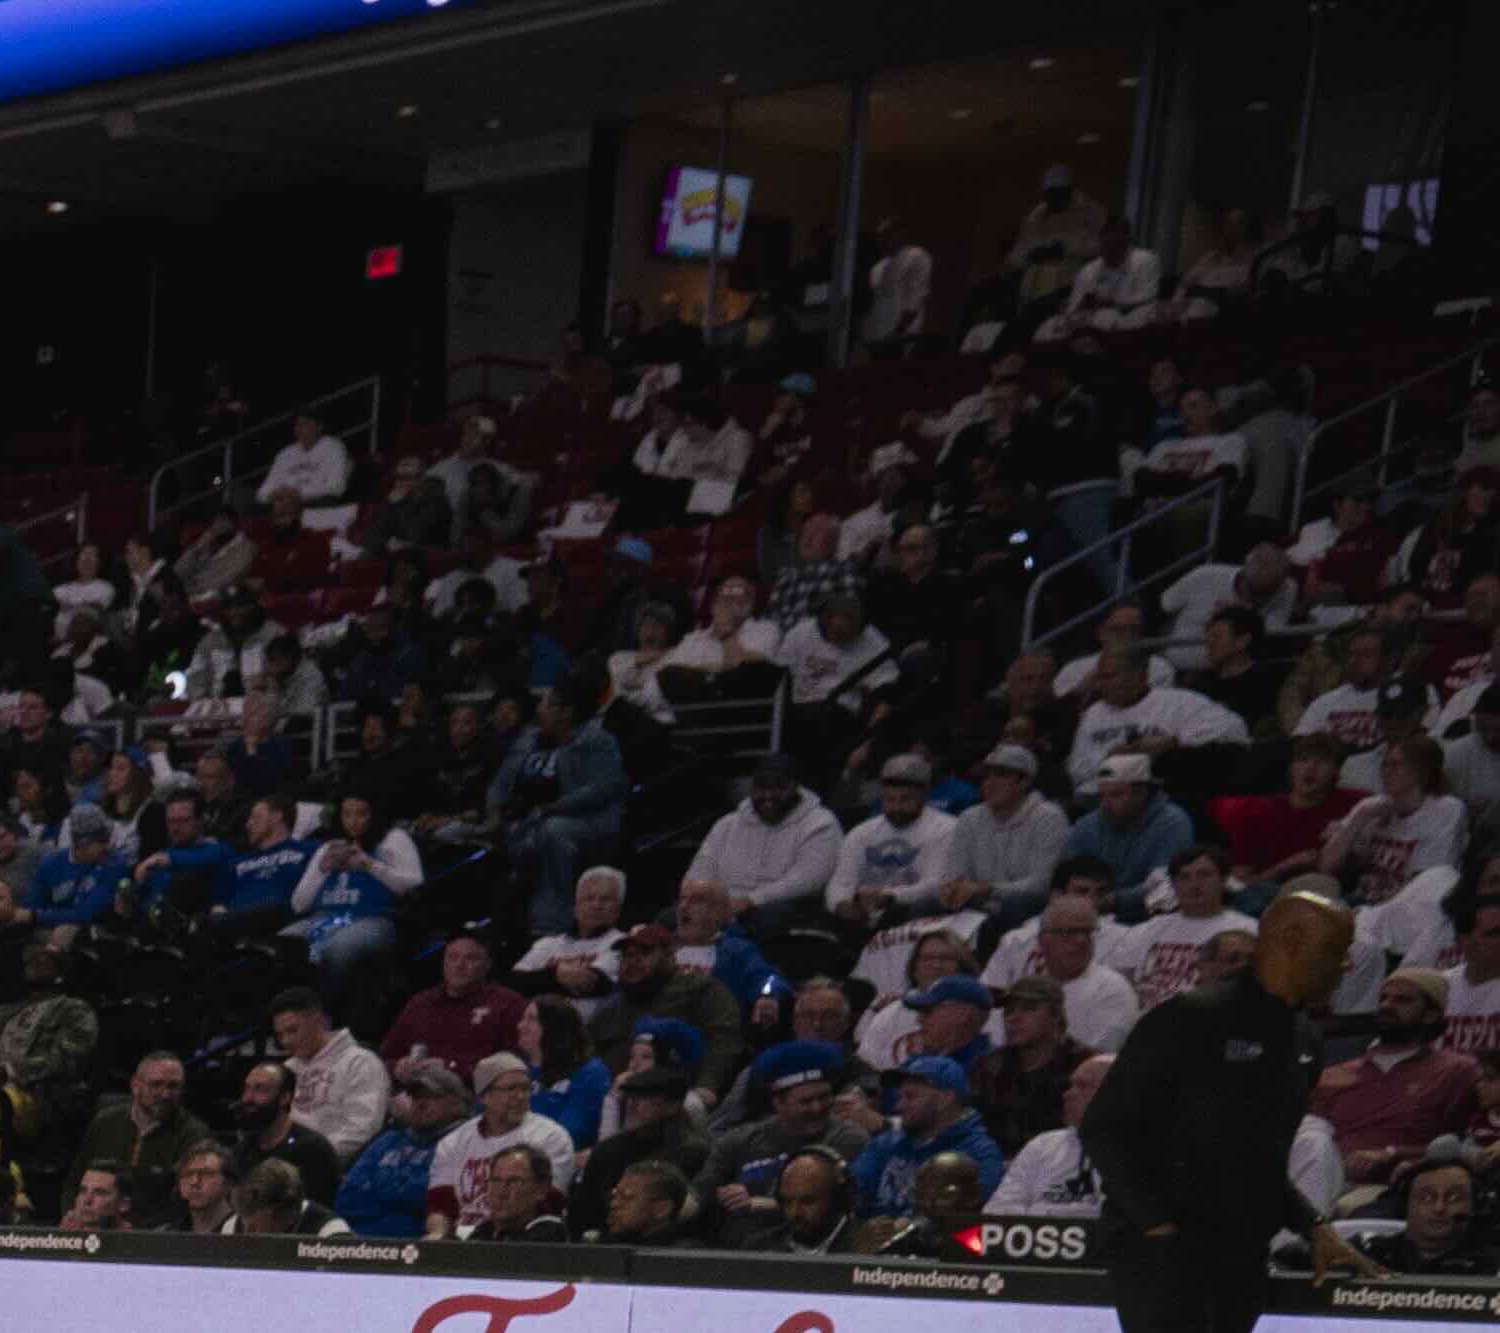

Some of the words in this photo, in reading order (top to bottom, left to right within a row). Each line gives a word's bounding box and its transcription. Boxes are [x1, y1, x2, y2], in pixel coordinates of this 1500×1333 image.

[297, 1242, 400, 1263] Independence
[980, 1224, 1086, 1260] POSS
[852, 1267, 980, 1291] Independence
[1332, 1287, 1486, 1312] Independence
